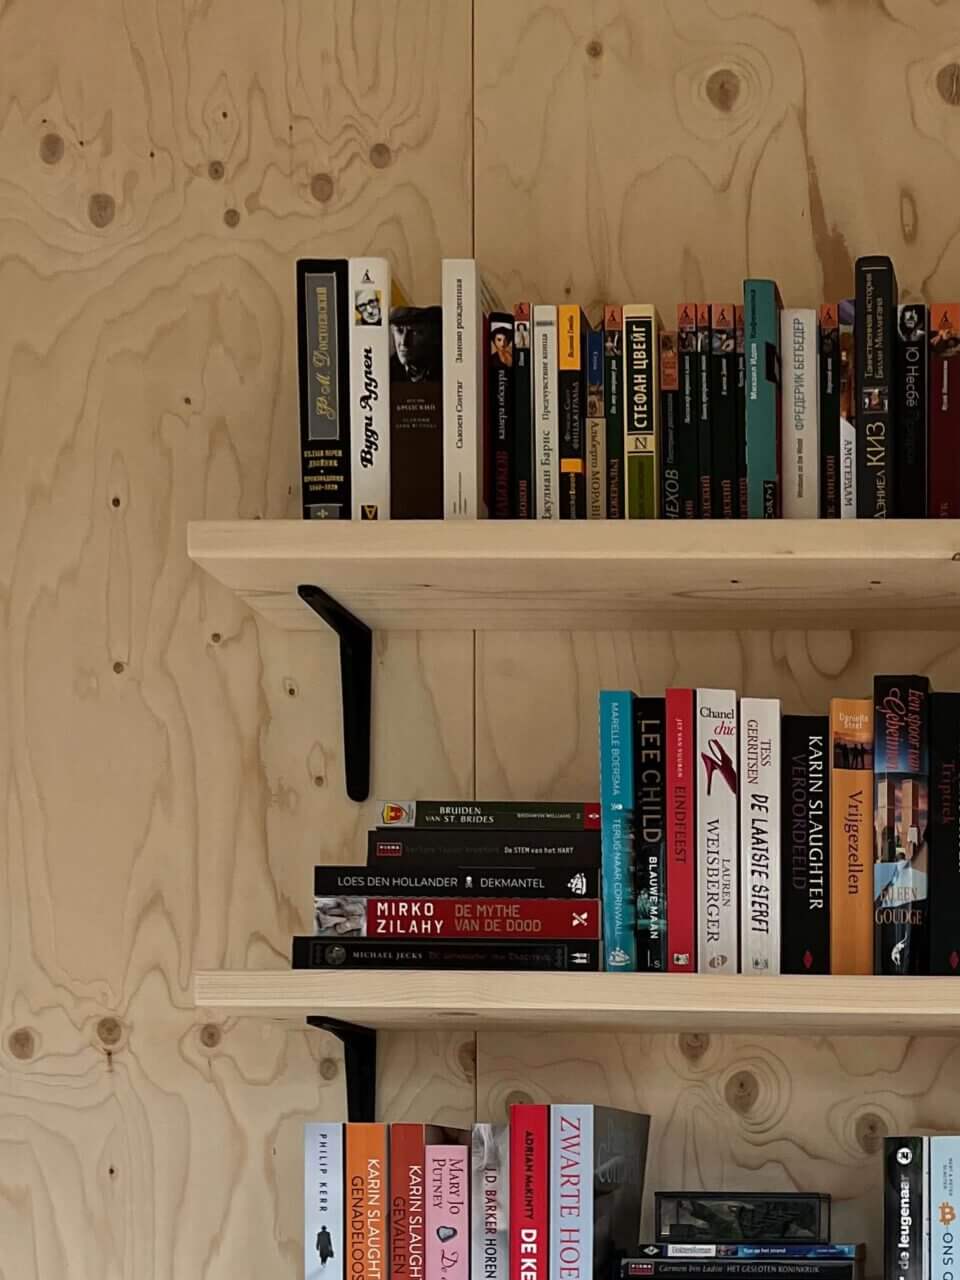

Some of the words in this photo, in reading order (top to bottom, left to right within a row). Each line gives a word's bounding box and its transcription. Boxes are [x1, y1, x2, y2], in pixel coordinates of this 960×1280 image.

[632, 325, 647, 369] ЦВЕЙГ
[907, 347, 919, 362] Ю
[634, 375, 647, 428] СТЕФАН
[700, 707, 734, 719] Chanel
[642, 720, 660, 762] LEE
[747, 719, 758, 784] GERRITSEN
[760, 739, 771, 766] TESS
[809, 736, 823, 792] KARIN
[643, 770, 661, 842] CHILD
[751, 794, 768, 813] DE
[752, 819, 768, 880] LAATSTE
[809, 800, 823, 909] SLAUGHTER
[844, 790, 863, 894] Vrijgezellen
[338, 877, 365, 886] LOES
[367, 878, 390, 886] DEN
[392, 878, 457, 887] HOLLANDER
[480, 878, 544, 888] DEKMANTEL
[649, 857, 658, 903] BLAUWE
[377, 903, 434, 916] MIRKO
[377, 920, 443, 933] ZILAHY
[650, 905, 658, 938] MAAN
[752, 885, 768, 934] STERFT
[368, 1159, 380, 1204] KARIN
[560, 1116, 581, 1218] ZWARTE
[485, 1190, 497, 1234] BARKER
[485, 1239, 497, 1278] HOREN
[521, 1229, 537, 1253] DE
[943, 1232, 953, 1265] ONS
